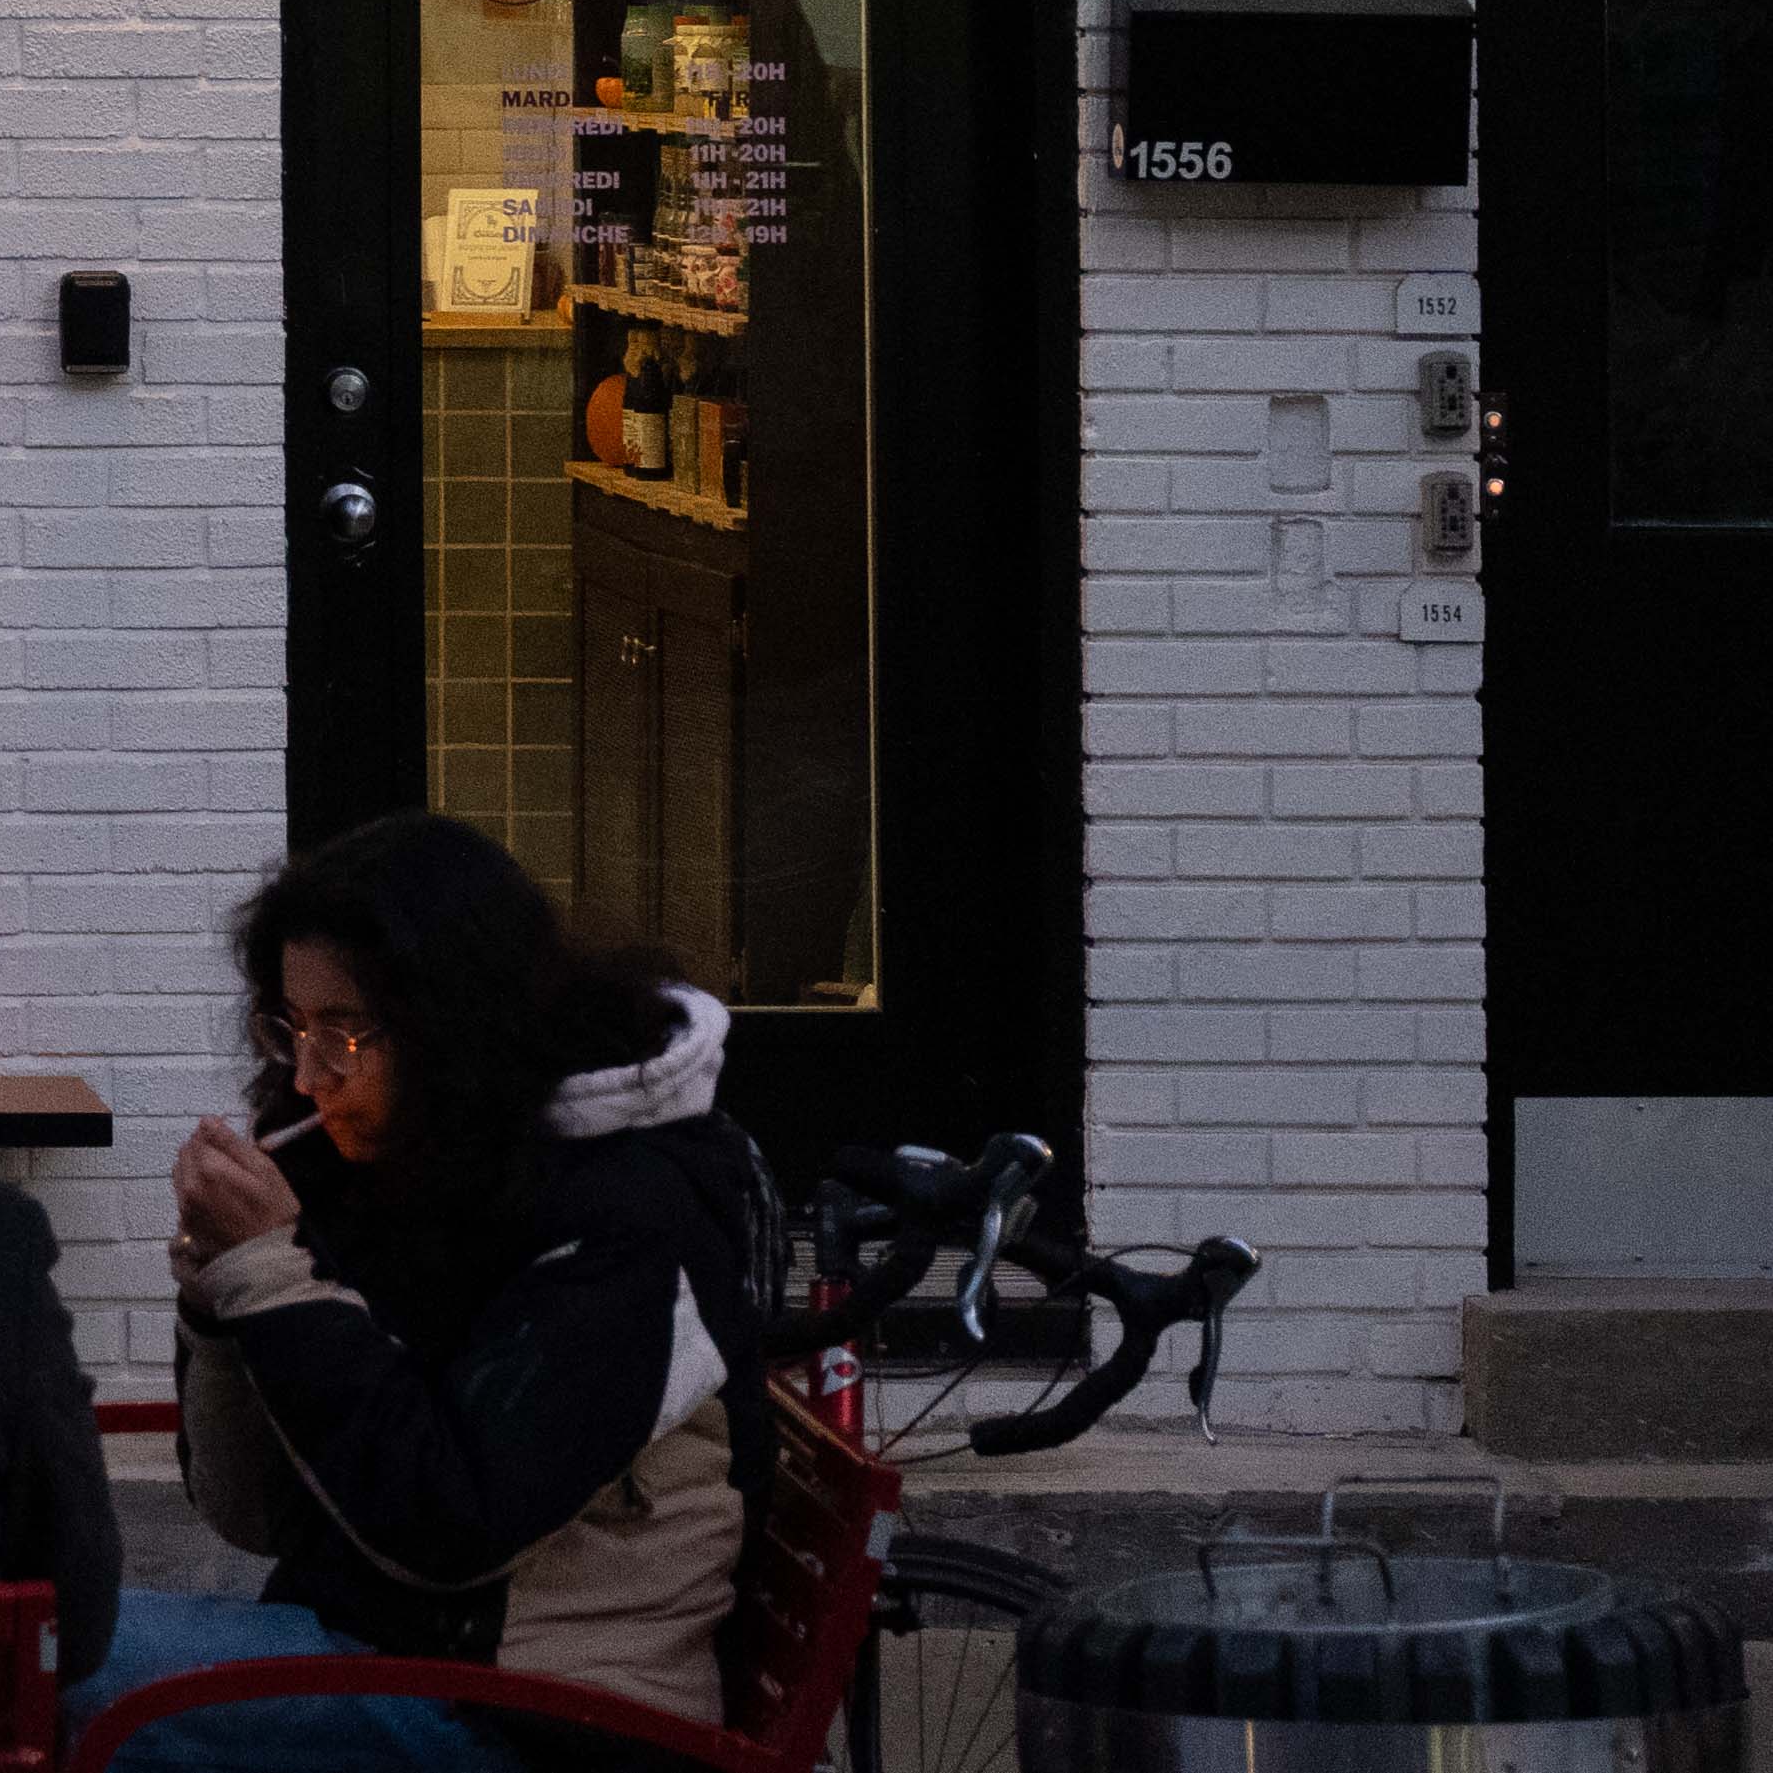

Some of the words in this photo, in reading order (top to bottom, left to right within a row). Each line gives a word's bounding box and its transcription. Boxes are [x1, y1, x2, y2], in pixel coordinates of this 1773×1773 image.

[501, 91, 572, 108] MARD
[738, 117, 786, 135] 20H
[739, 144, 786, 162] 20H
[1129, 140, 1232, 180] 1556
[745, 171, 786, 189] 21H
[746, 198, 786, 216] 21H
[745, 226, 787, 244] 19H
[1417, 296, 1457, 316] 1552
[1422, 603, 1462, 624] 1554
